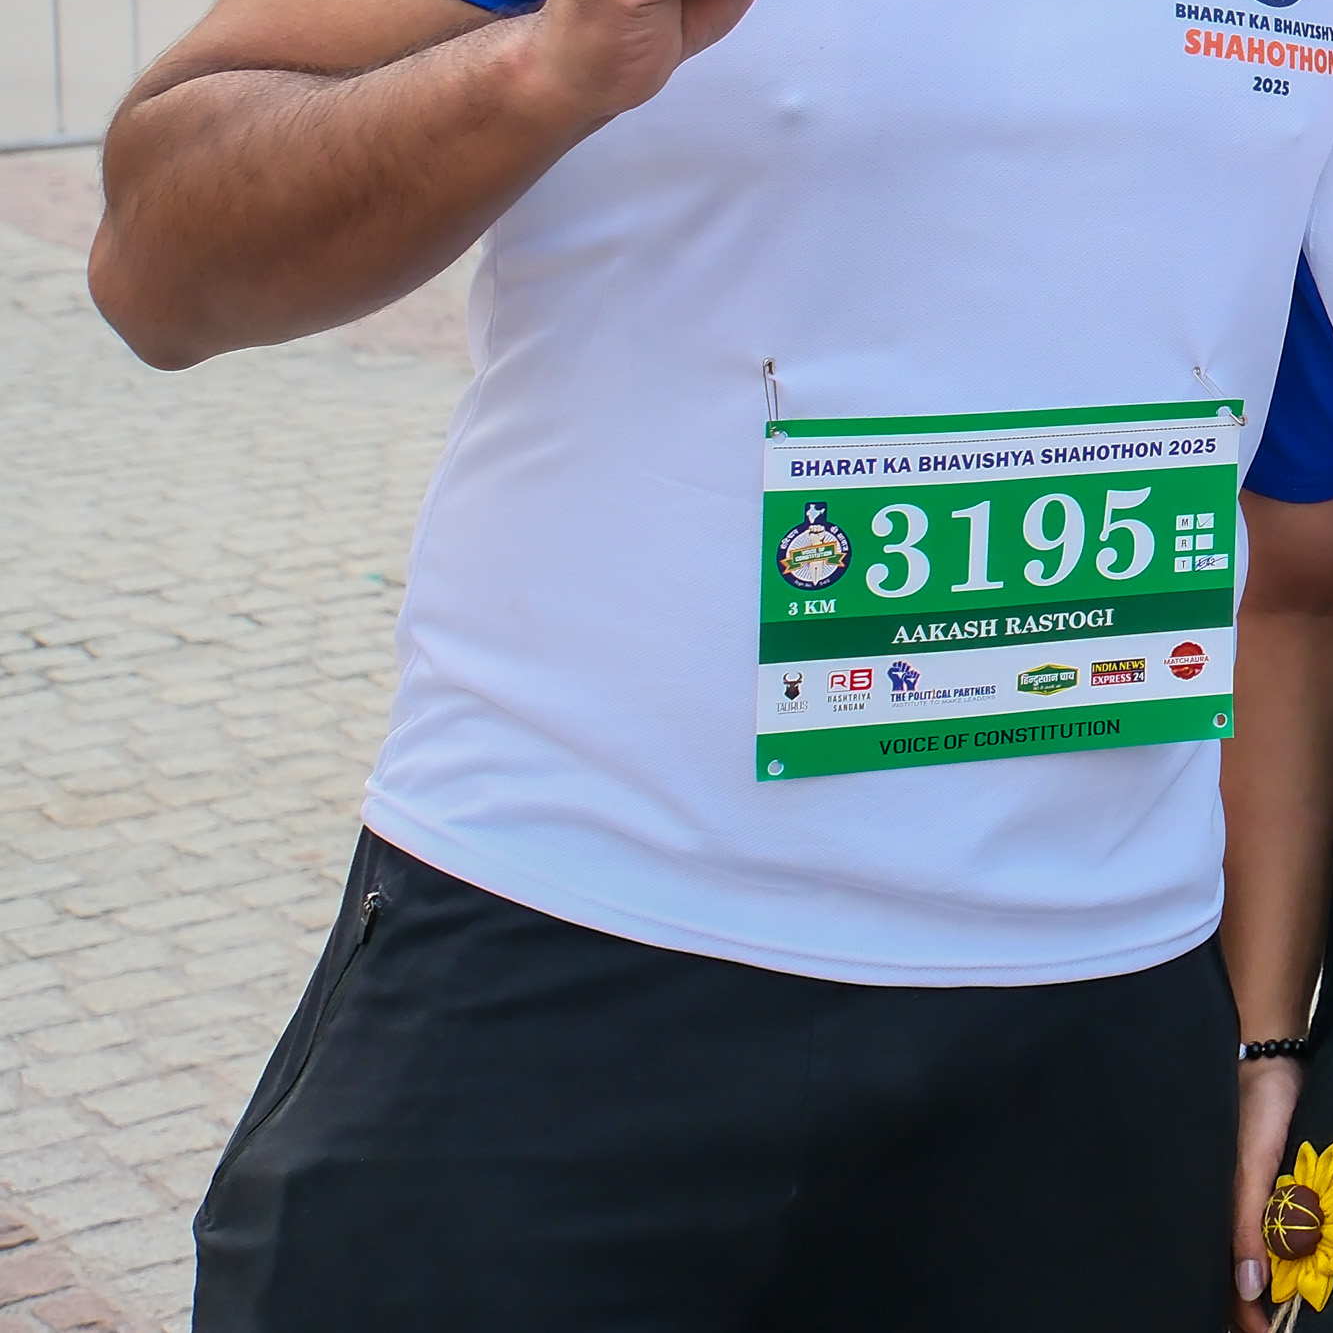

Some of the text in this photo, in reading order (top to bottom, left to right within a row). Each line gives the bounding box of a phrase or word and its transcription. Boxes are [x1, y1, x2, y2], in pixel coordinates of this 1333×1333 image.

[1175, 3, 1246, 27] BHARAT
[1249, 13, 1271, 31] KA
[1252, 76, 1290, 96] 2025
[790, 437, 1217, 477] BHARAT KA BHAVISHYA SHAHOTHON 2025
[865, 486, 1157, 598] 3195
[788, 599, 836, 616] 3 KM
[892, 608, 1115, 645] AAKASH RASTOGI
[1092, 659, 1145, 672] INDIA NEWS
[1092, 671, 1145, 685] EXPRESS 24
[890, 685, 996, 702] THE POLITICAL PARTNERS
[879, 717, 1121, 755] VOICE OF CONSTITUTION
